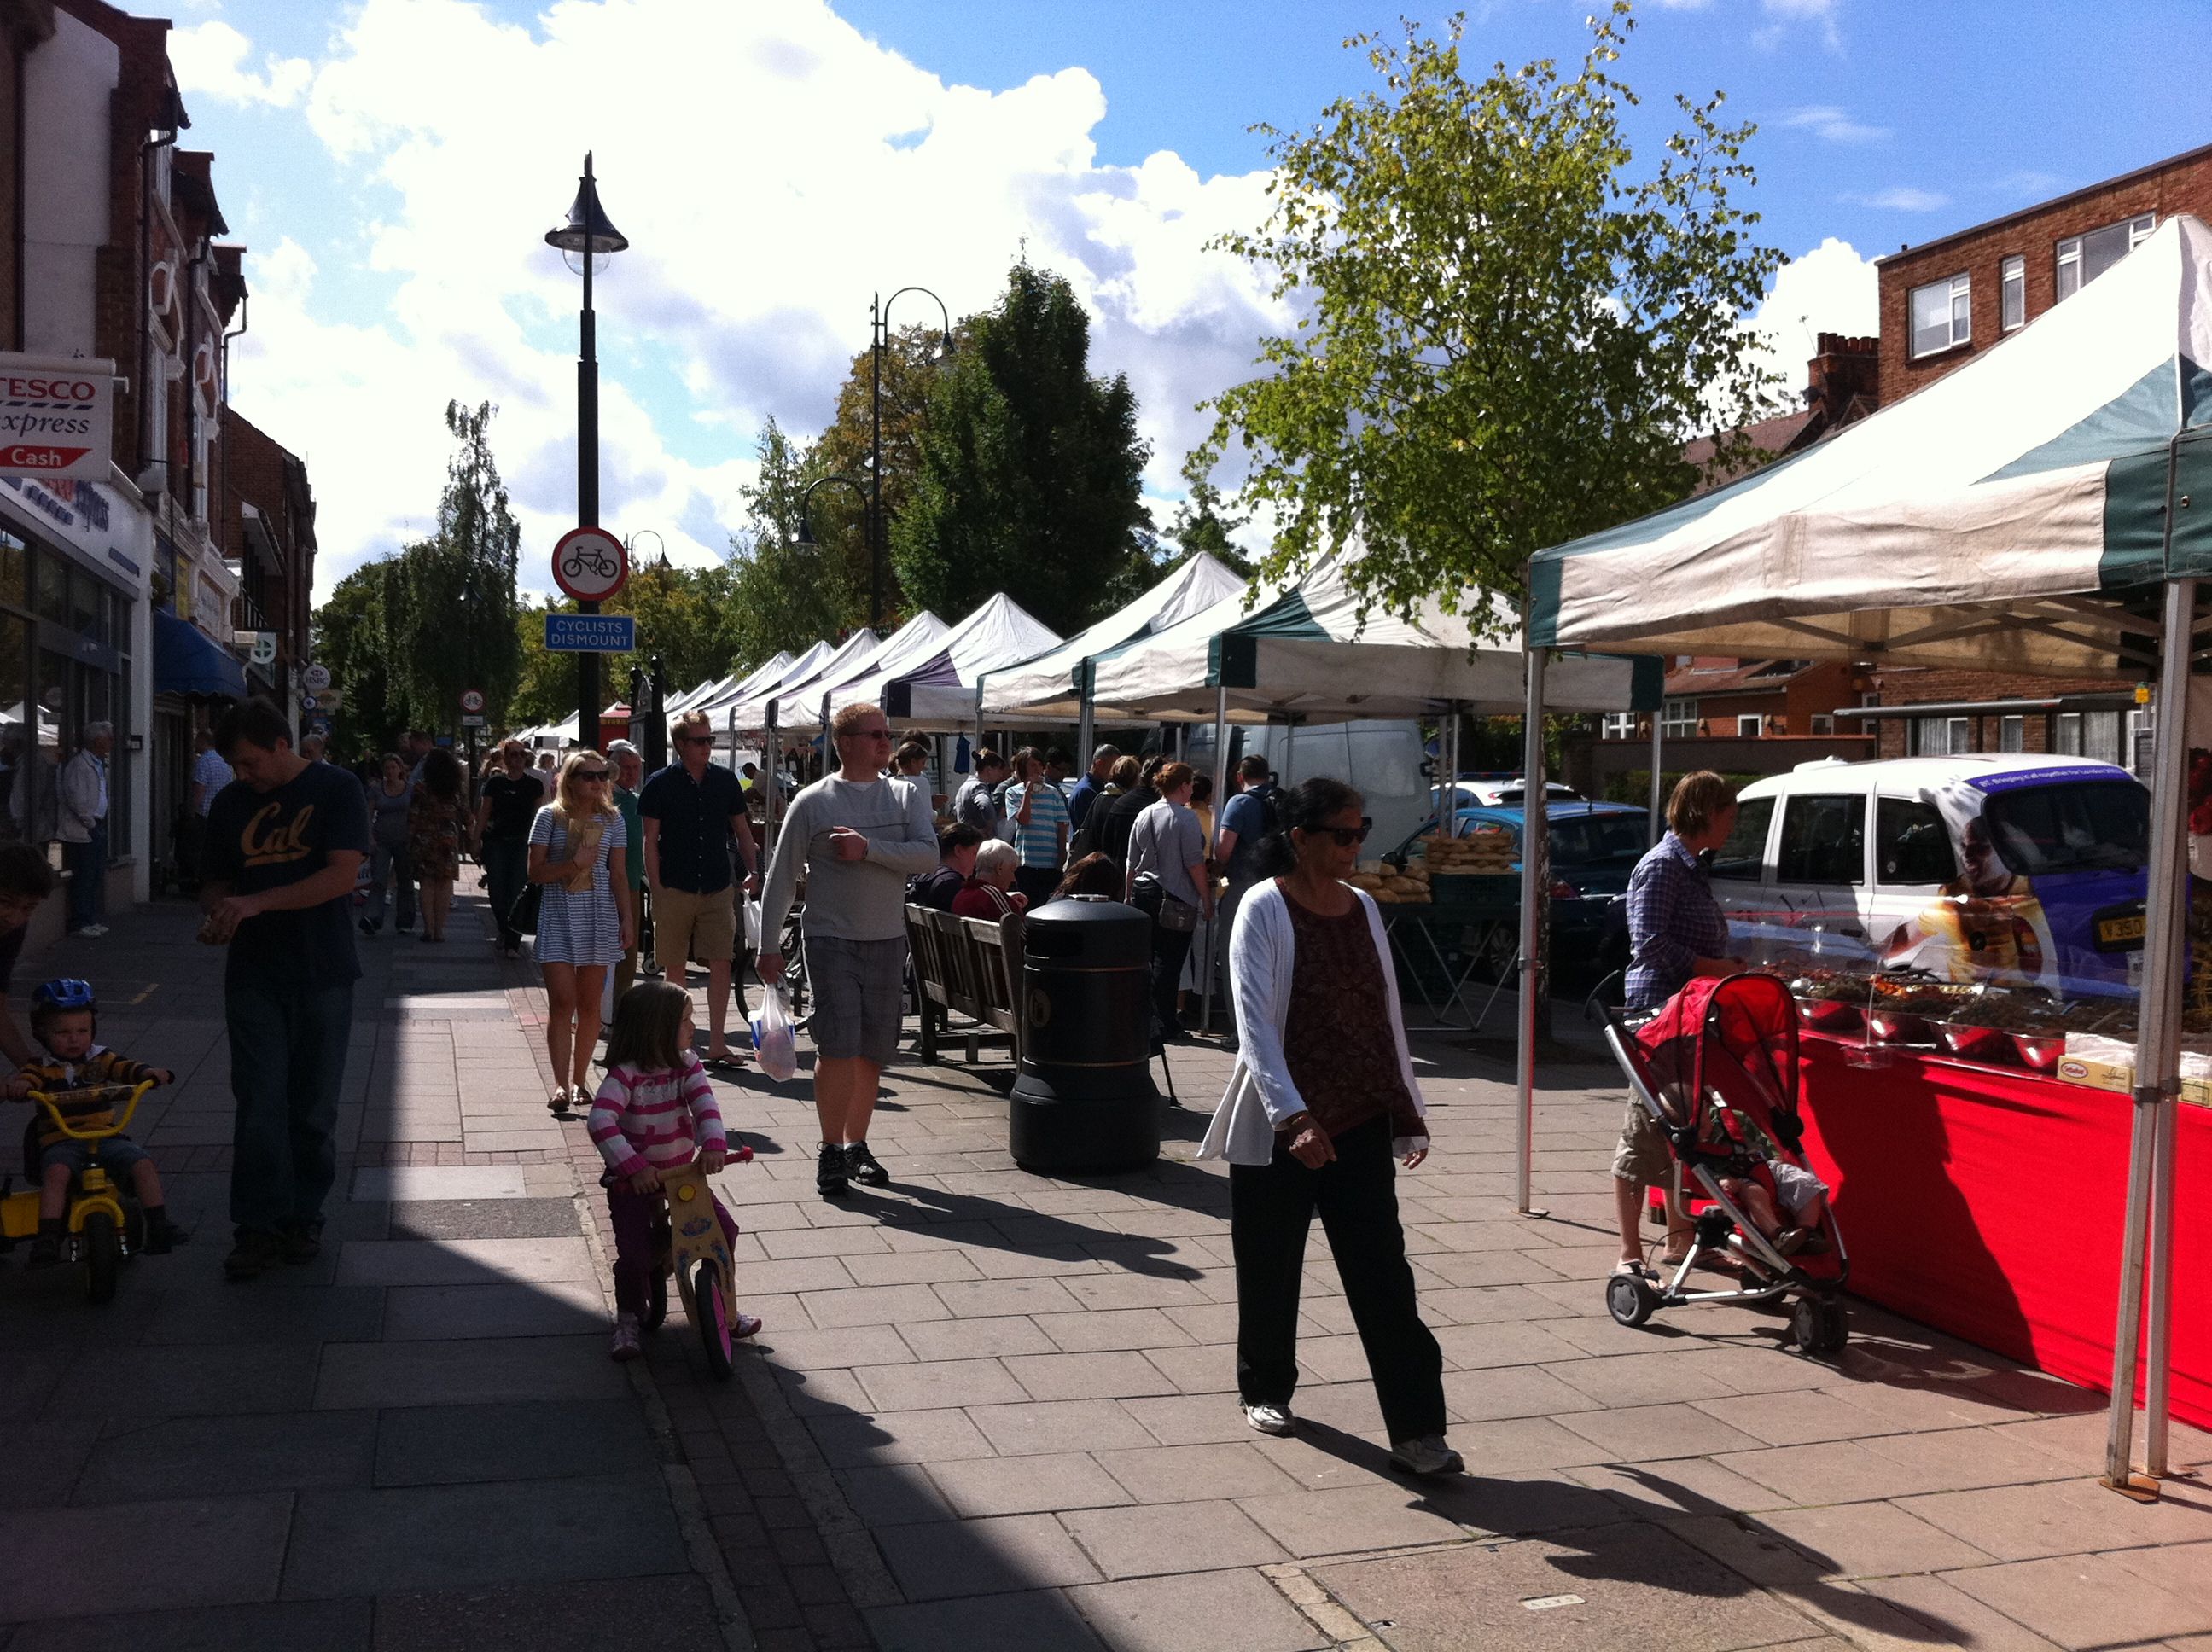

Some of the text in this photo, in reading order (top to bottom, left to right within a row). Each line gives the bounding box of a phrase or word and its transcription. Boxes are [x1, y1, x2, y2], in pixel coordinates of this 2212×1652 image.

[0, 413, 90, 437] xpress
[11, 447, 62, 467] Cash
[556, 620, 622, 633] CYCLISTS
[551, 634, 628, 646] DISMOUNT
[241, 801, 315, 867] Cal
